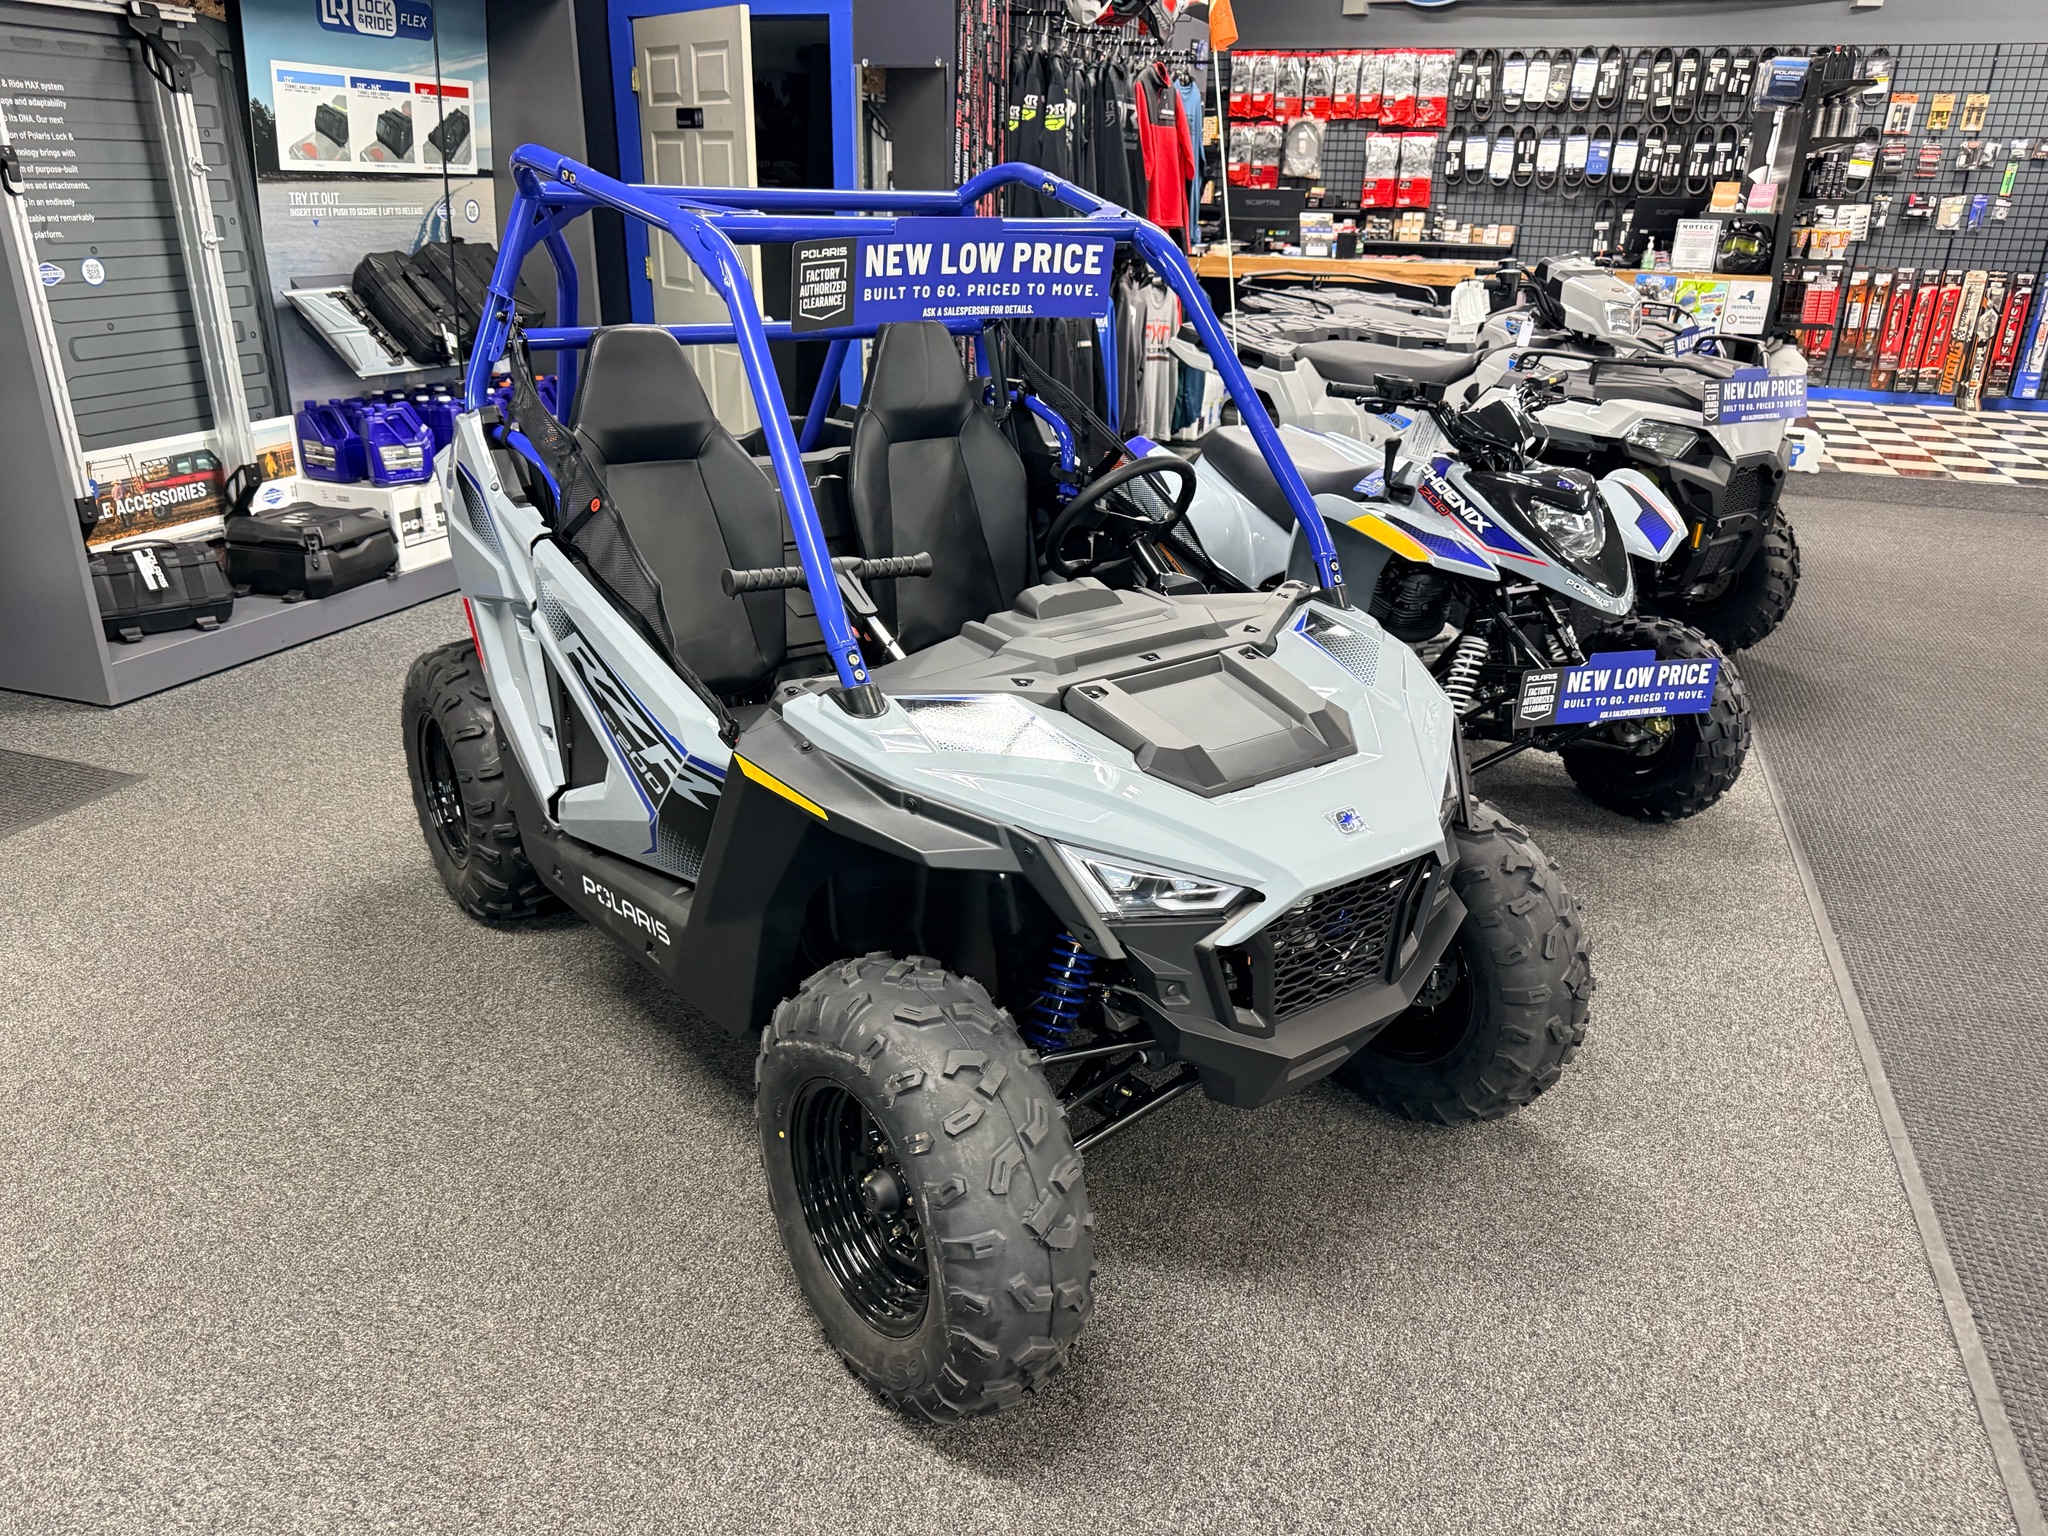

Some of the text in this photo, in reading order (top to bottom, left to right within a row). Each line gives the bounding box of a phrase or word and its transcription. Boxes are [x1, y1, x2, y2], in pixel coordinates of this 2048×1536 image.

[357, 0, 393, 16] LOCK
[400, 13, 427, 28] FLEX
[2, 79, 65, 92] & Ride MAX system
[14, 97, 67, 109] and adaptability
[8, 113, 18, 122] its
[18, 114, 36, 123] DNA.
[35, 115, 48, 123] Our
[49, 116, 65, 124] next
[19, 131, 27, 139] of
[27, 130, 51, 140] Polaris
[51, 132, 68, 140] Lock
[68, 132, 75, 140] &
[39, 148, 76, 159] brings with
[954, 127, 963, 184] MOTORSPORTS
[27, 165, 34, 173] of
[35, 165, 79, 175] purpose-built
[35, 182, 48, 190] and
[28, 198, 36, 206] in
[36, 198, 46, 206] an
[45, 198, 75, 207] endlessly
[288, 191, 340, 205] TRY IT OUT
[46, 213, 95, 223] and remarkably
[290, 206, 424, 217] INSERT FEET PUSH TO SECURE LIFT TO RELEASE
[34, 230, 65, 240] platform.
[800, 246, 848, 260] POLARIS
[864, 241, 1105, 278] NEW LOW PRICE
[805, 267, 841, 282] FACTORY
[799, 281, 848, 298] AUTHORIZED
[863, 283, 1100, 302] BUILT TO GO. PRICED TO MOVE.
[802, 294, 843, 310] CLEARANCE
[922, 304, 1035, 317] ASK A SALESPERSON FOR DETAILS.
[1723, 379, 1804, 401] NEW LOW PRICE
[1722, 404, 1738, 413] BUILT
[1738, 404, 1746, 412] TO
[1746, 403, 1755, 411] GO.
[1755, 402, 1776, 411] PRICED
[1784, 400, 1804, 408] MOVE.
[116, 481, 208, 516] ACCESSORIES
[1415, 462, 1492, 535] PHOENIX
[1418, 484, 1450, 516] 200
[145, 547, 170, 589] POLARIS
[1565, 578, 1611, 608] POLARIS
[1526, 673, 1558, 682] POLARIS
[1566, 663, 1713, 694] NEW LOW PRICE
[1527, 686, 1552, 696] FACTORY
[1522, 695, 1555, 706] AUTHORIZED
[1563, 690, 1707, 709] BUILT TO GO. PRICED TO MOVE.
[1523, 704, 1551, 714] CLEARANCE
[1599, 711, 1609, 719] ASK
[1613, 708, 1641, 718] SALESPERSON
[1641, 708, 1650, 716] FOR
[1649, 706, 1667, 715] DETAILS.
[615, 729, 665, 795] 200
[581, 874, 671, 946] POLARIS
